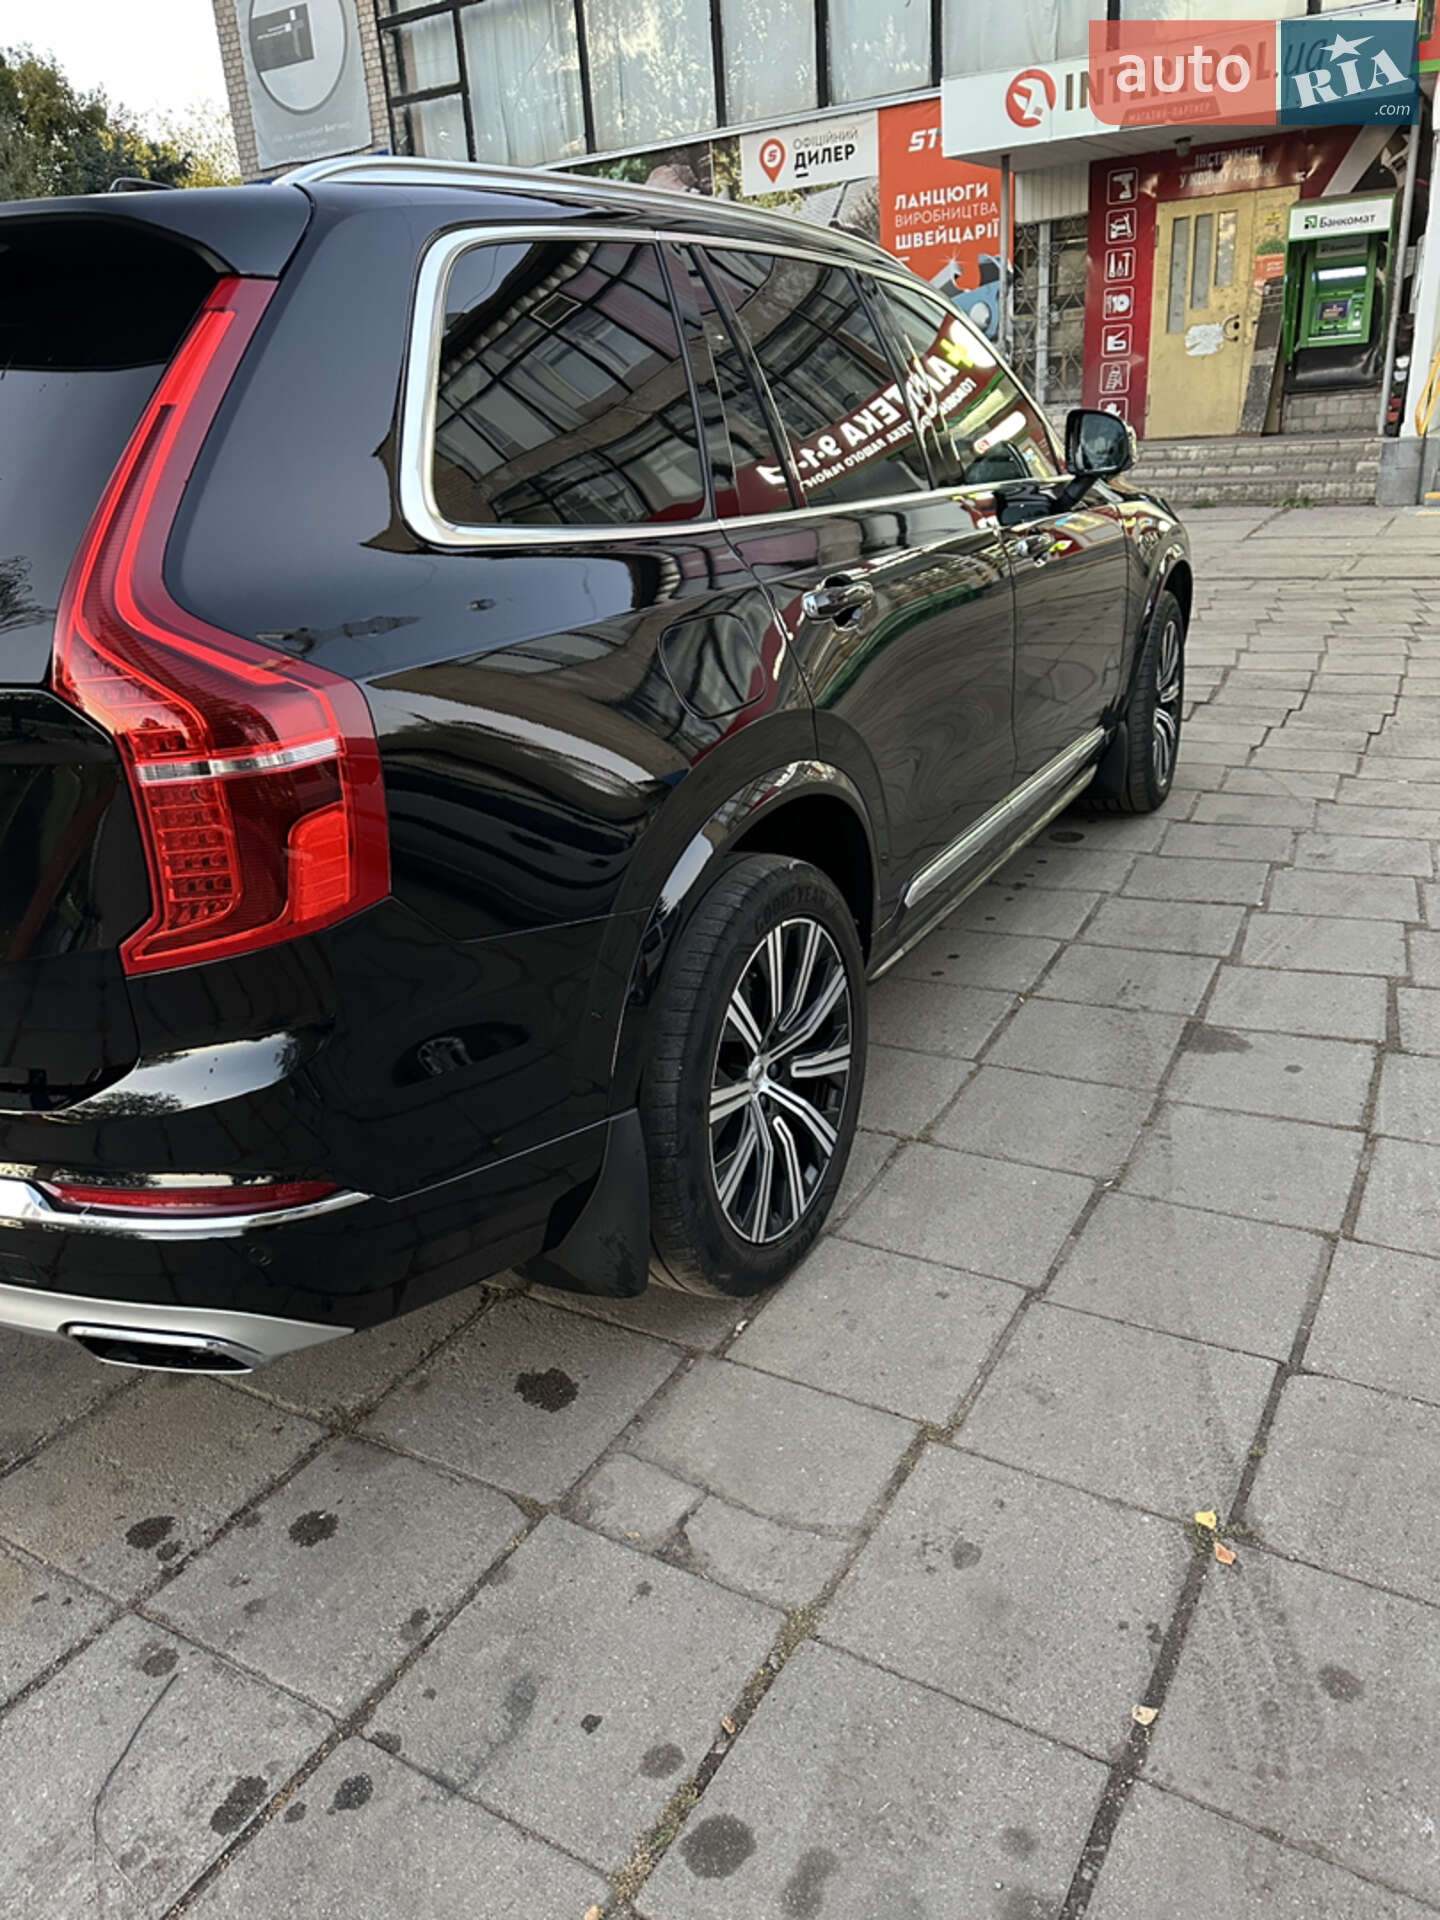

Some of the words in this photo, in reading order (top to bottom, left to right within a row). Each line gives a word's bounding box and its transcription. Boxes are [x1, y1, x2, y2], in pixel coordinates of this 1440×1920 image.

[792, 127, 859, 151] ОФІЦІЙНИЙ
[794, 144, 855, 170] ДИЛЕР
[895, 182, 988, 210] ЛАНЦЮГИ
[895, 201, 998, 228] ВИРОБНИЦТВА
[1319, 214, 1376, 229] Банкомат
[895, 219, 999, 250] ШВЕЙЦАРІЇ
